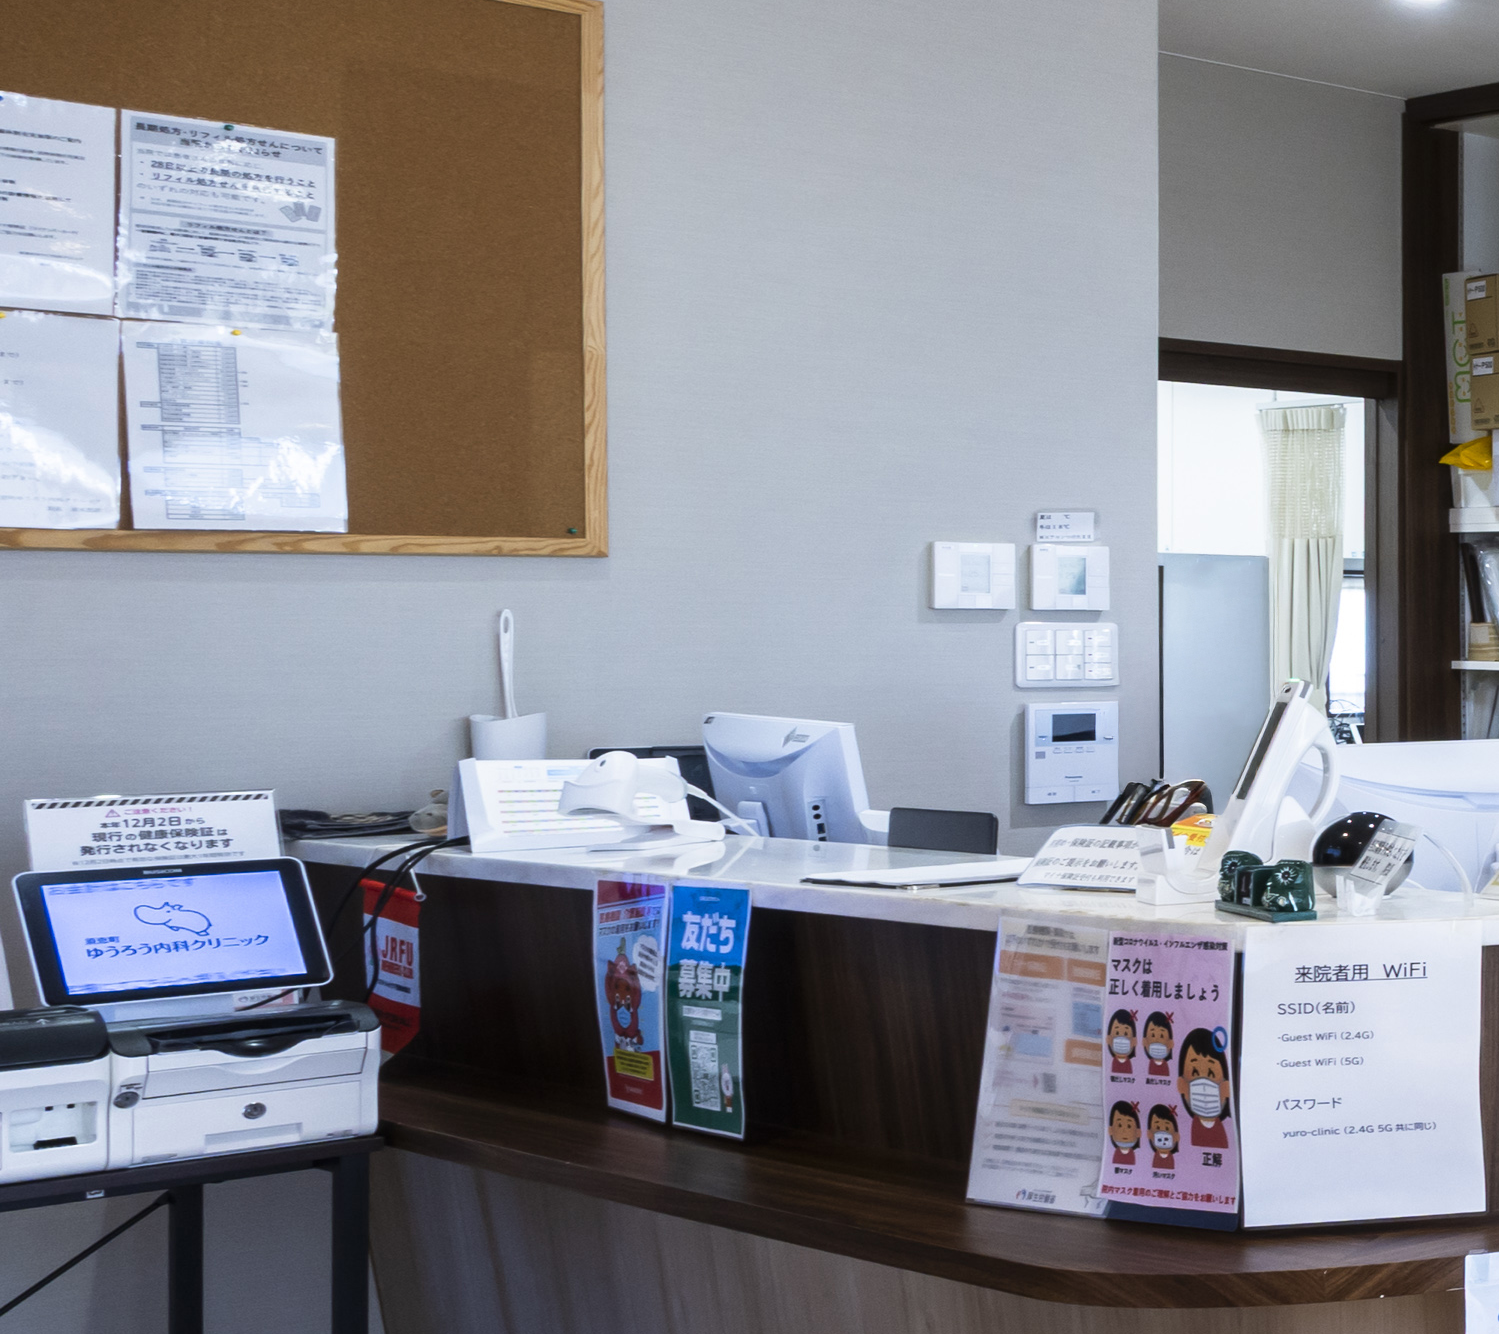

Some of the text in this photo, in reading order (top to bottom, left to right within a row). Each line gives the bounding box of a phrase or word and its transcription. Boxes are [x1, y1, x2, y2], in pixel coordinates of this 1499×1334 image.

[99, 815, 207, 830] 本年12月2日から
[91, 827, 229, 842] 現行の健康保険証は
[79, 838, 234, 857] 発行されなくなります
[681, 911, 737, 955] 友だち
[86, 934, 270, 960] ゆうろう内科クリニック
[382, 935, 414, 967] JRFU
[1111, 958, 1153, 975] マスクは
[1295, 962, 1428, 982] 来院者用 WiFi
[678, 958, 732, 1002] 募集中
[1108, 978, 1221, 1002] 正しく着用しましょう
[1315, 1032, 1337, 1041] WiFi
[1315, 1058, 1337, 1067] WiFi
[1275, 1097, 1343, 1111] パスワード
[1282, 1127, 1341, 1139] yuro-clinic
[1377, 1124, 1393, 1133] 5G
[1202, 1152, 1223, 1167] 正解
[1101, 1184, 1237, 1205] 院内マスク着用のご理解とご協力をお願いします
